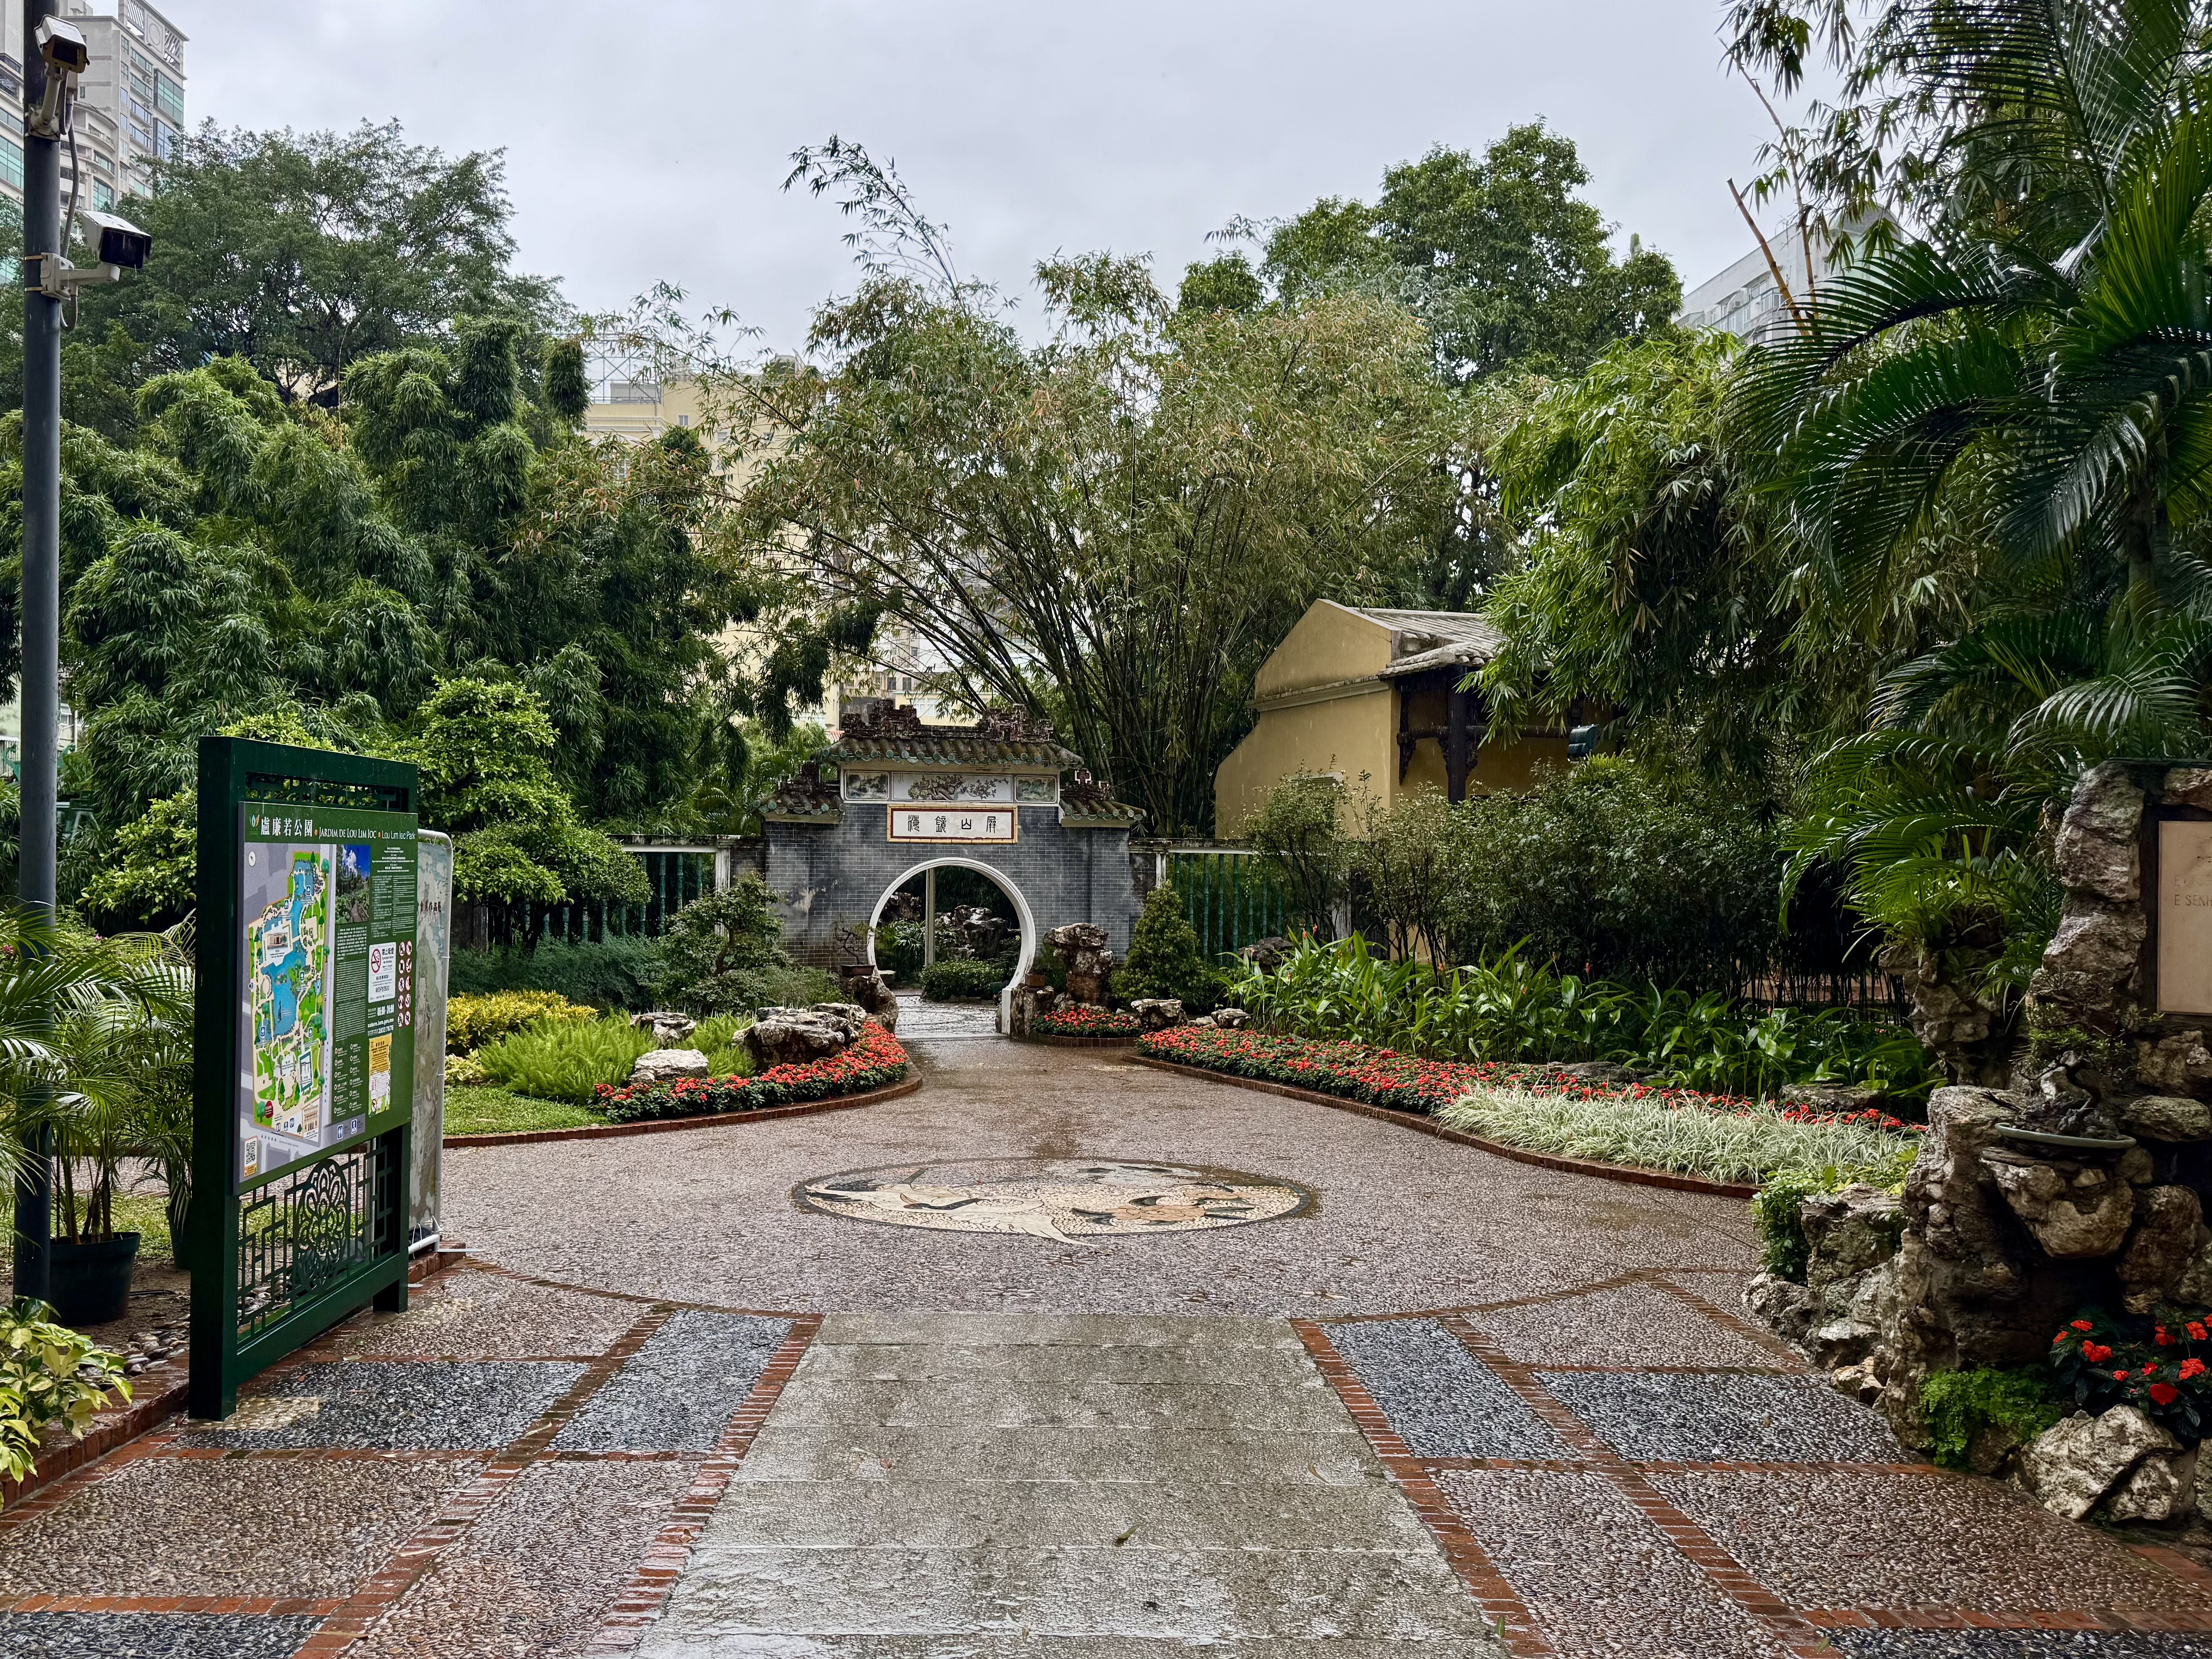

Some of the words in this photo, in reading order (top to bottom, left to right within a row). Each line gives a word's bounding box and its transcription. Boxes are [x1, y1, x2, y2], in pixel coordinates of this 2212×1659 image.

[261, 816, 313, 837] 盧廉若公園
[318, 827, 338, 839] JARDIM
[339, 829, 346, 838] DE
[347, 828, 357, 838] LOU
[358, 828, 367, 838] LIM
[368, 829, 377, 839] IOC
[382, 830, 390, 839] Lou
[407, 831, 415, 839] Park
[2174, 894, 2180, 906] E
